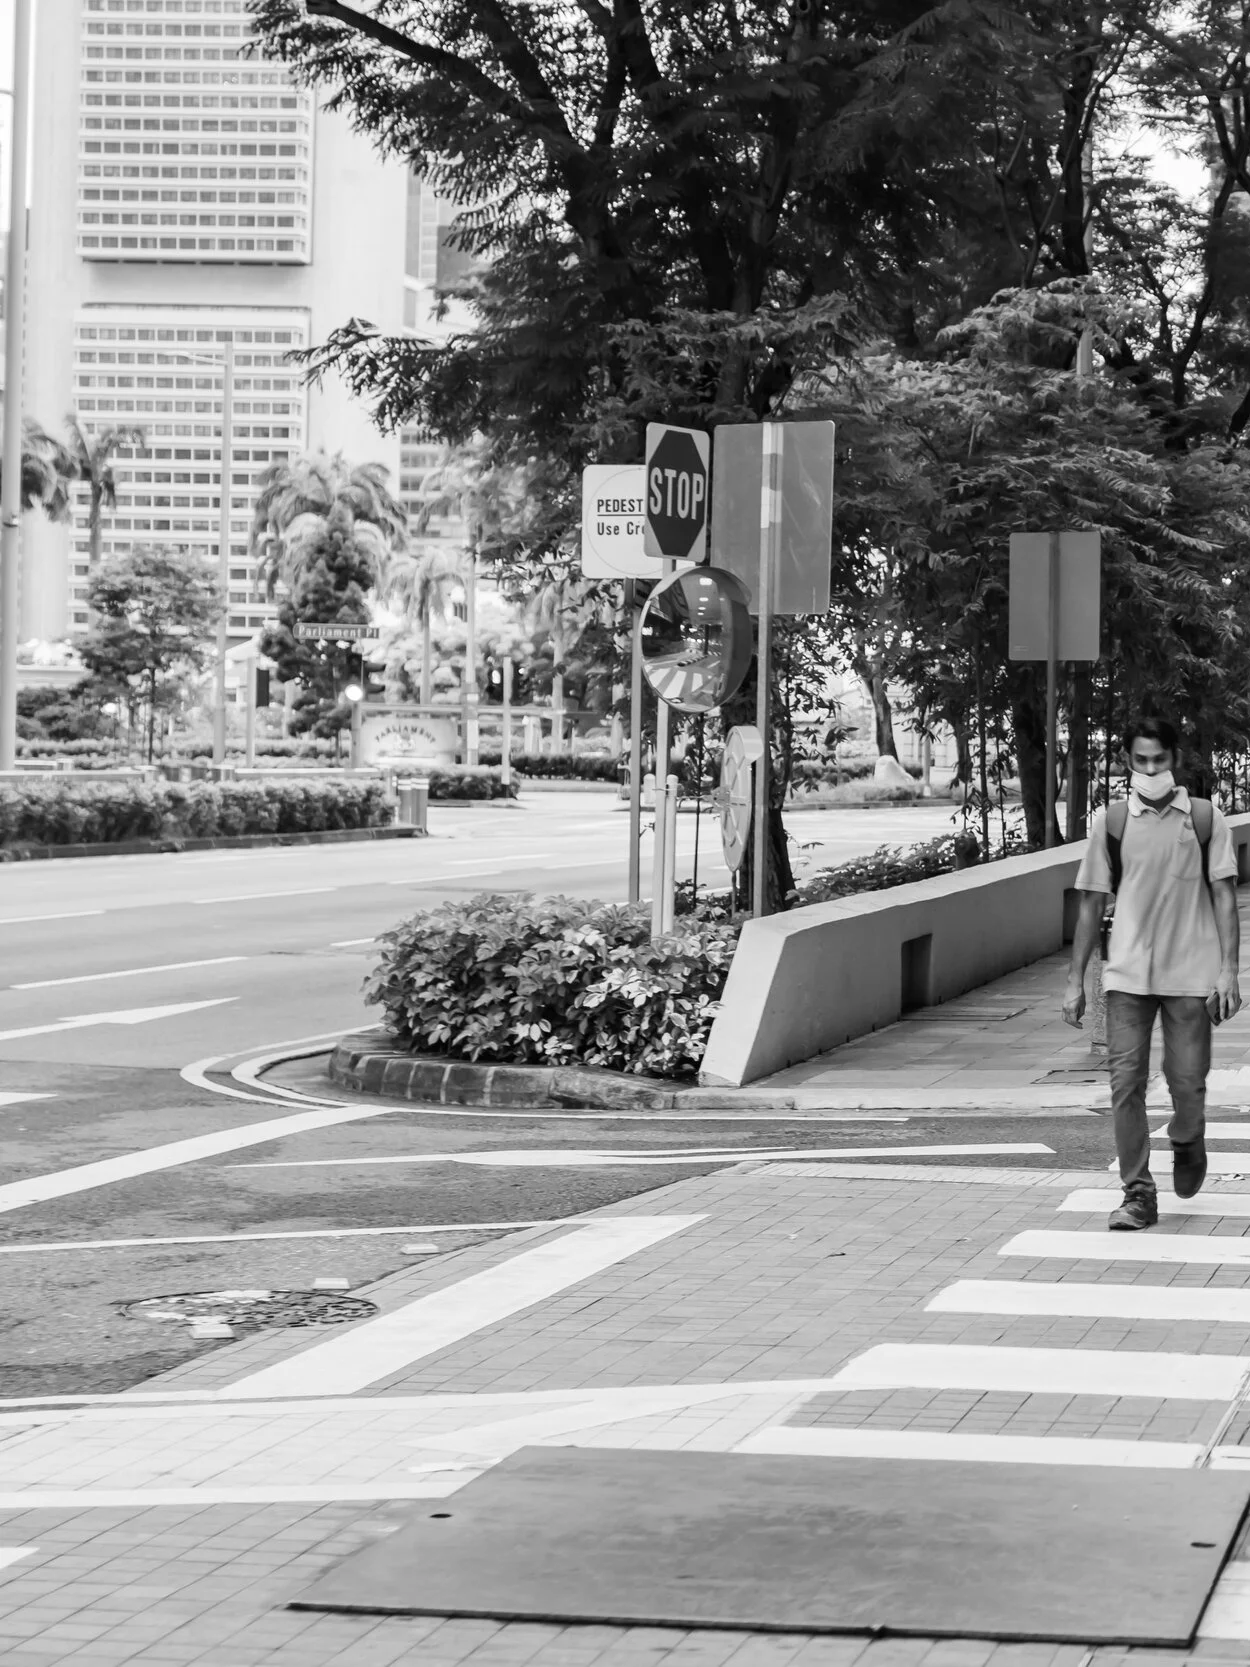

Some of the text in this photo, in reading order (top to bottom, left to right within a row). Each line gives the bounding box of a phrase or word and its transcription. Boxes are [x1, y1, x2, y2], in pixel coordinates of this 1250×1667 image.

[649, 467, 705, 520] STOP
[597, 498, 644, 513] PEDEST
[597, 521, 620, 536] Use
[298, 624, 361, 637] Parliament
